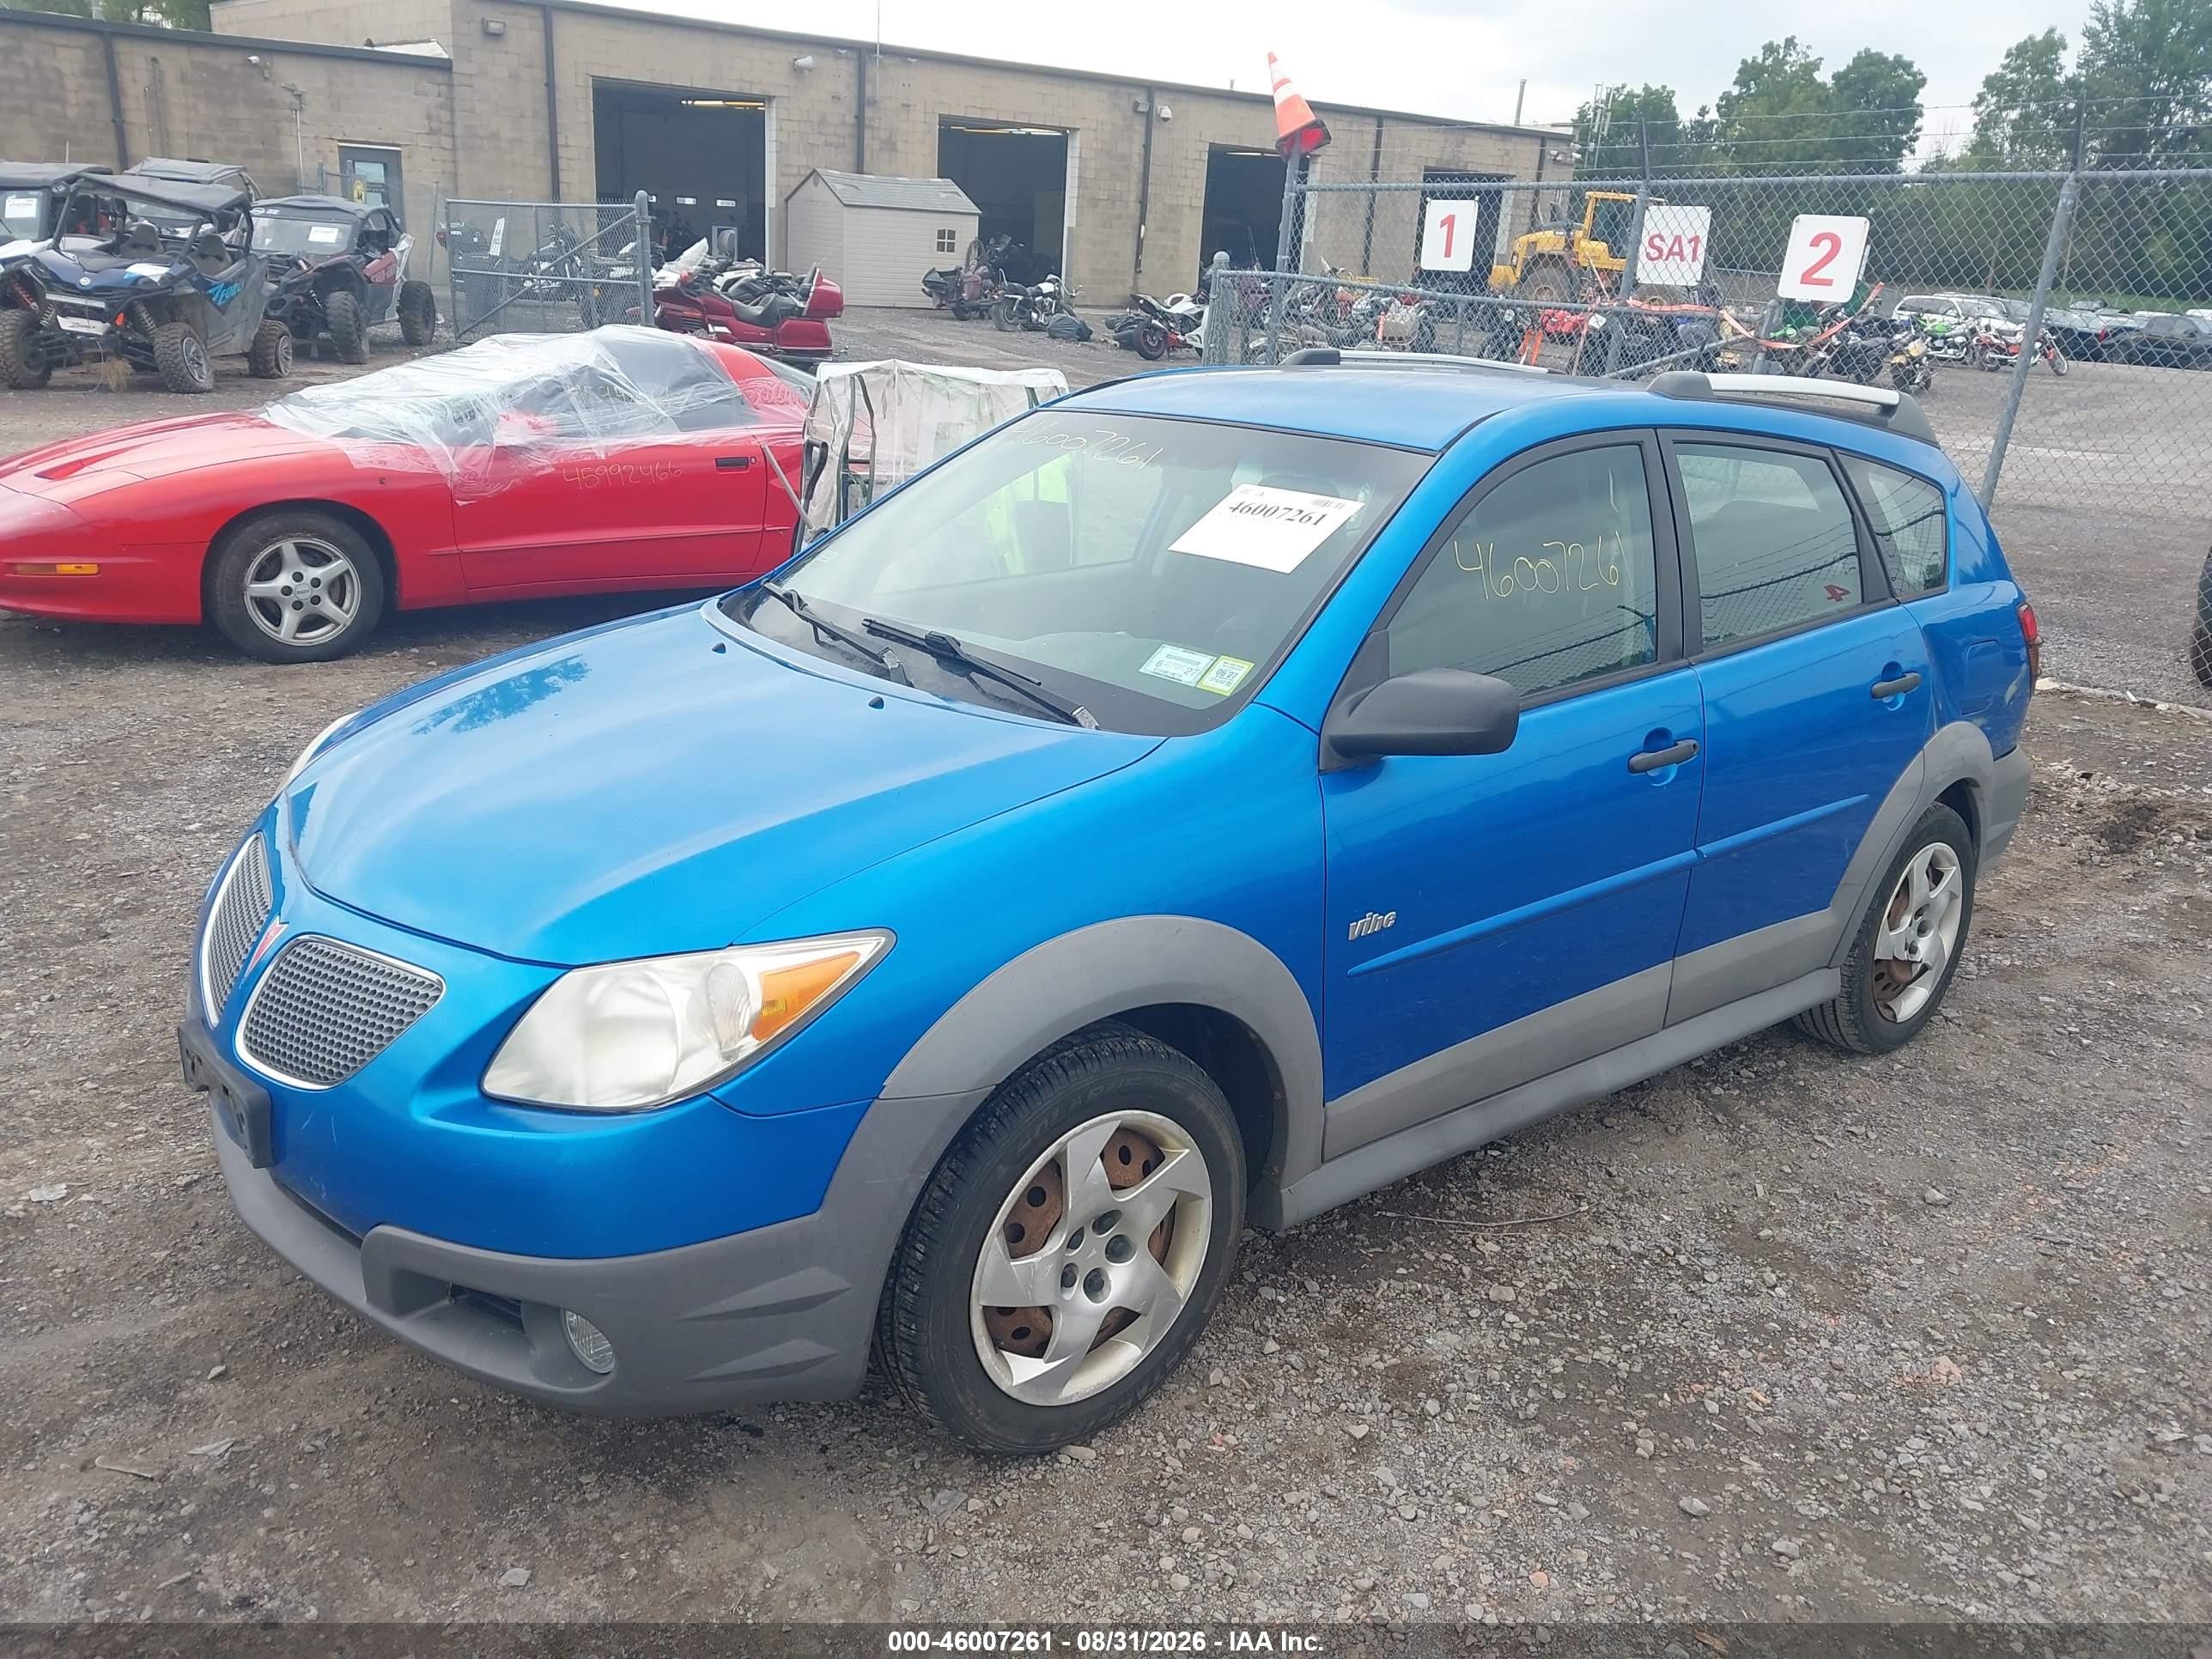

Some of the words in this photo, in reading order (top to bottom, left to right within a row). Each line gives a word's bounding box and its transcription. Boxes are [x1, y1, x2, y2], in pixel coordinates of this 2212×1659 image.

[1439, 214, 1456, 258] 1
[1646, 234, 1701, 263] SA1
[1799, 232, 1843, 287] 2
[1012, 420, 1164, 470] 46007261
[563, 461, 683, 489] 45992466
[1229, 501, 1328, 526] 46007261
[1454, 530, 1633, 600] 46007261
